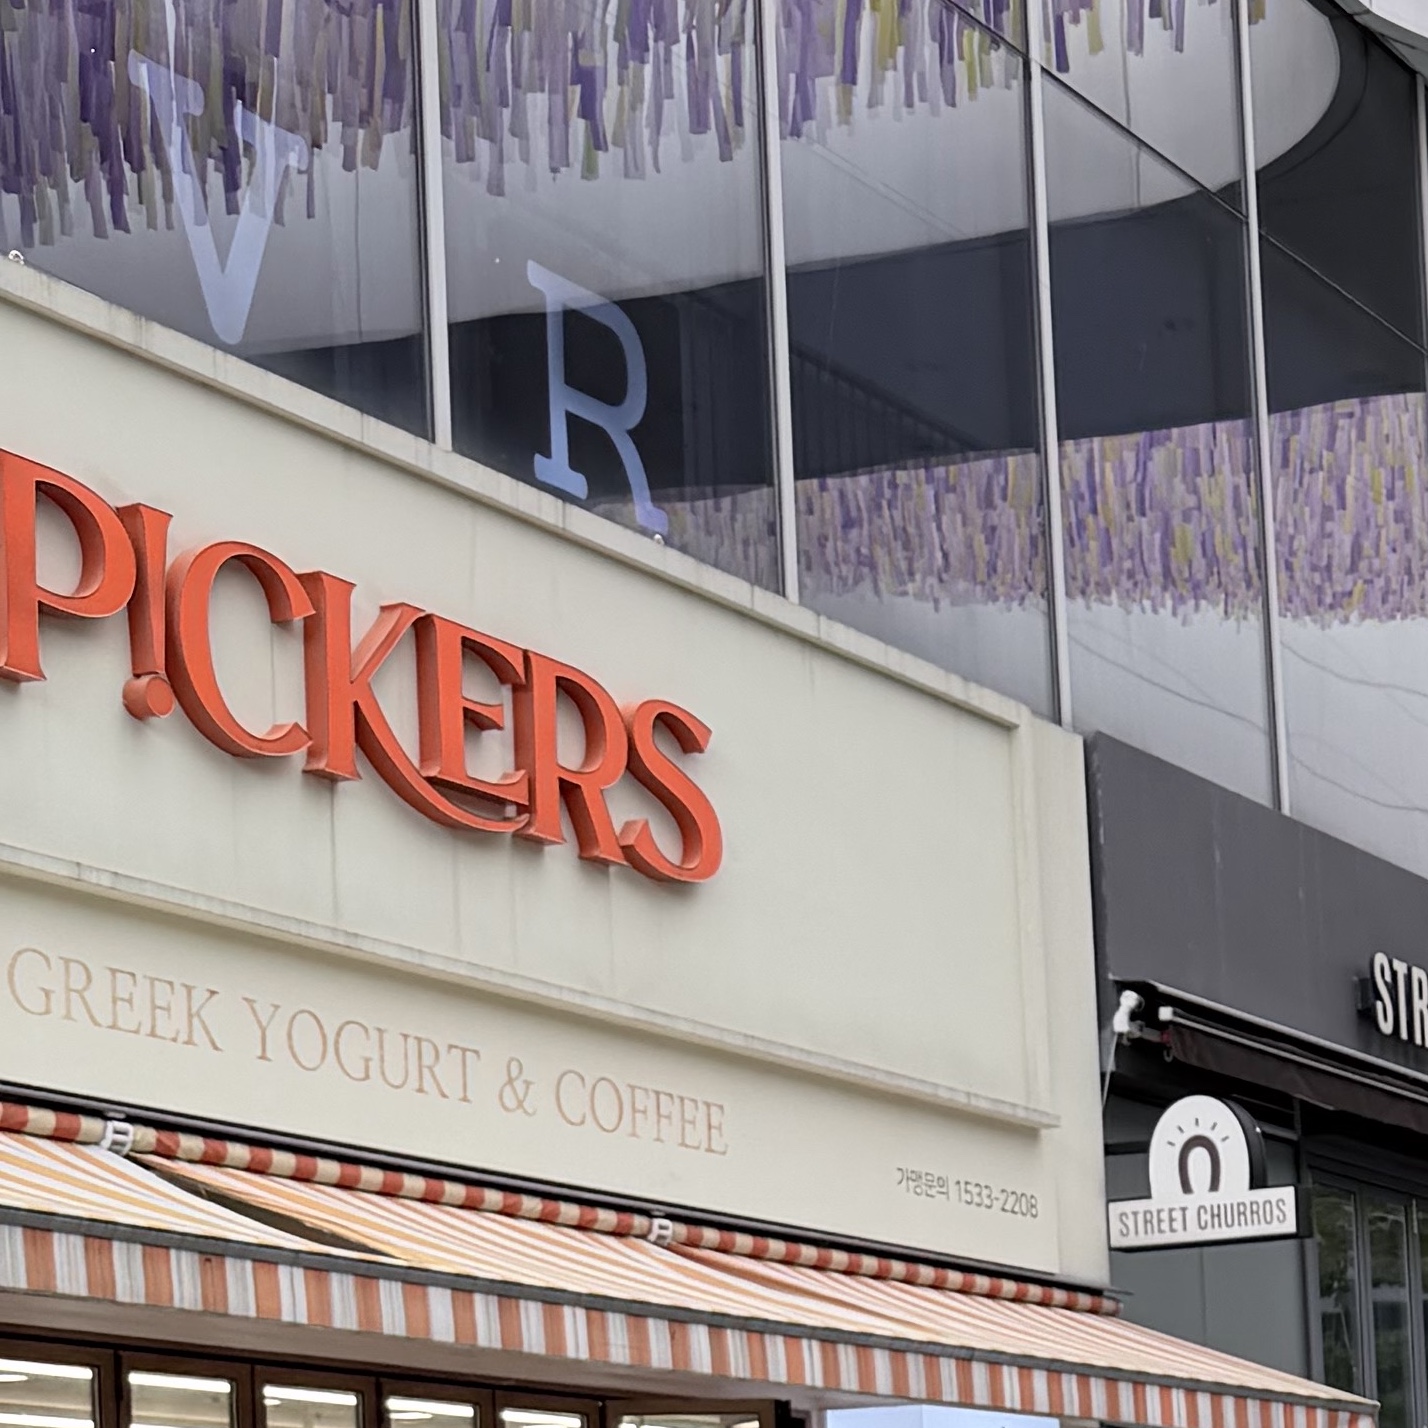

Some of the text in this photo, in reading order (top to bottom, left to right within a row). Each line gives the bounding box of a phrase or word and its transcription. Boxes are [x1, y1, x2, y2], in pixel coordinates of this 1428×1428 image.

[527, 260, 668, 535] R
[7, 948, 729, 1156] GREEK YOGURT & COFFEE
[897, 1167, 1038, 1219] 가맹문의 1533-2208
[1119, 1198, 1286, 1237] STREET CHURROS
